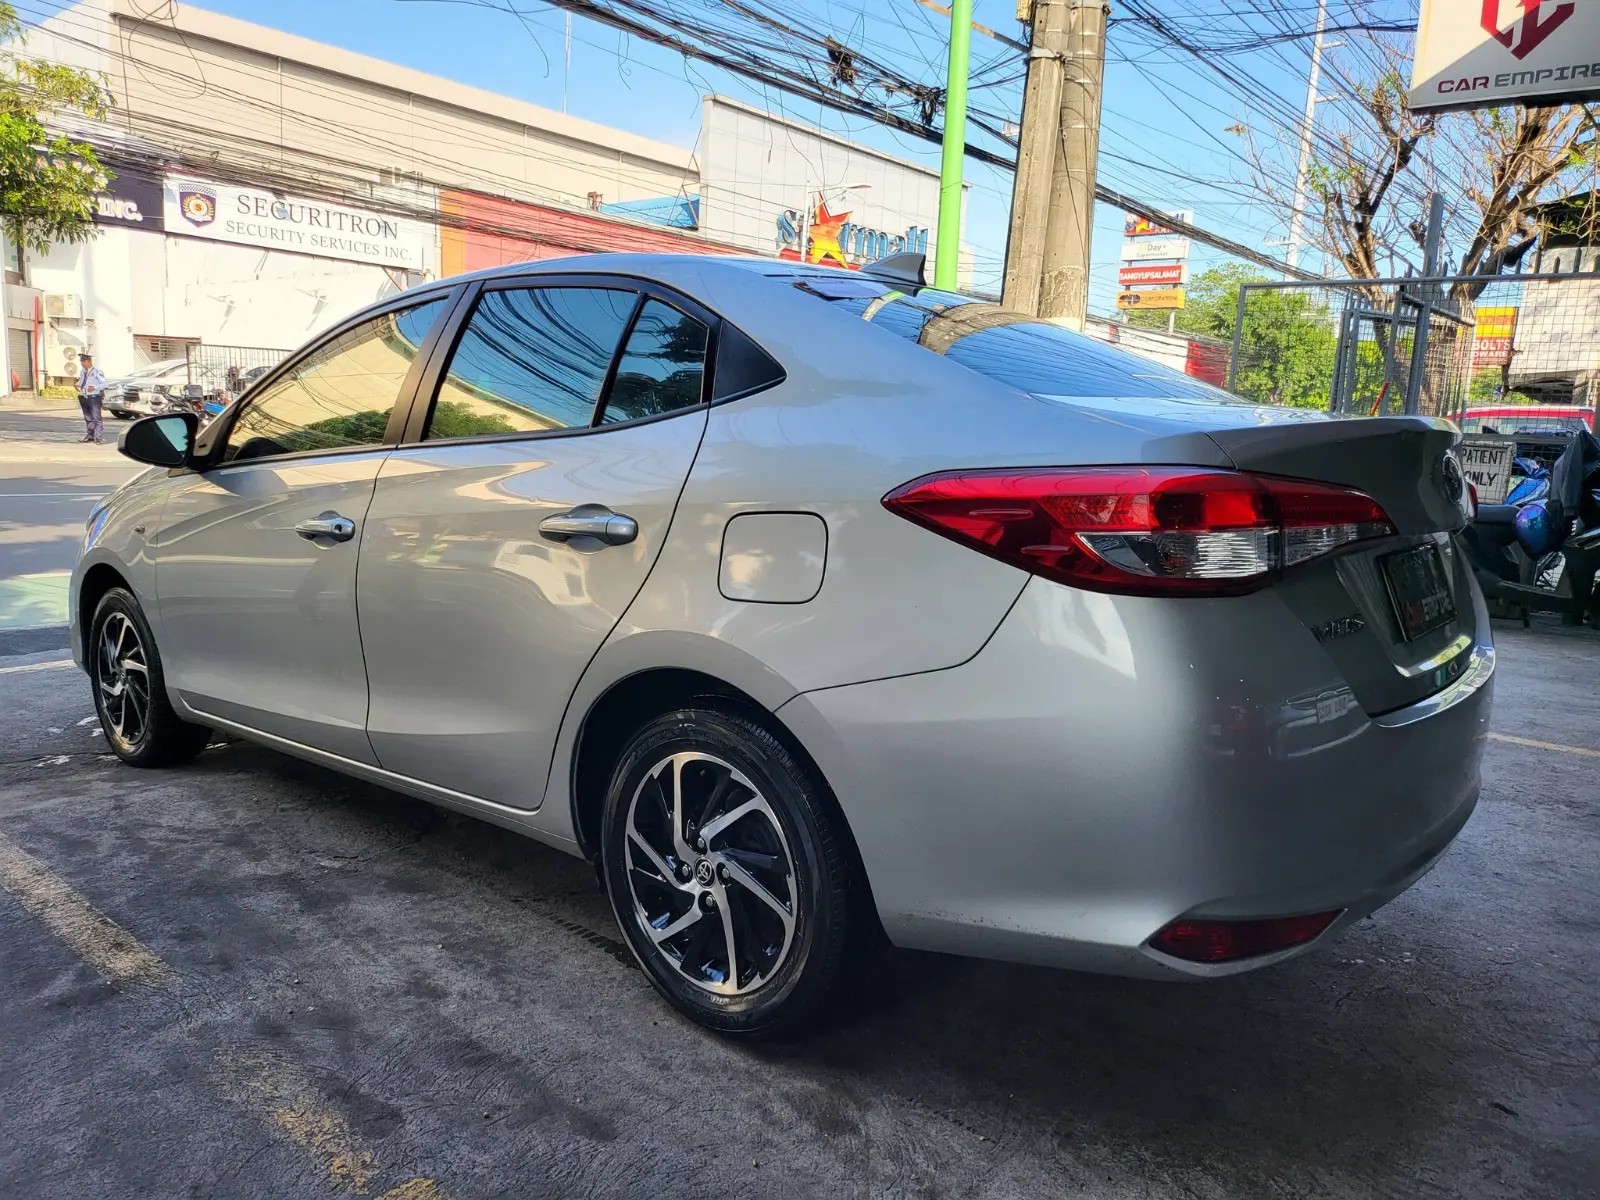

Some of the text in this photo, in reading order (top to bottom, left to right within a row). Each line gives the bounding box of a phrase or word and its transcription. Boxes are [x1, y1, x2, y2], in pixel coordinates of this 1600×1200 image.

[1437, 63, 1600, 94] CAR EMPIRE
[97, 197, 143, 221] INC.
[237, 194, 399, 240] SECURITRON
[226, 220, 413, 261] SECURITY SERVICES INC.
[1119, 269, 1181, 281] SAMGYUPSALAMAT
[1471, 340, 1511, 350] BOLTS
[1462, 447, 1506, 465] PATIENT
